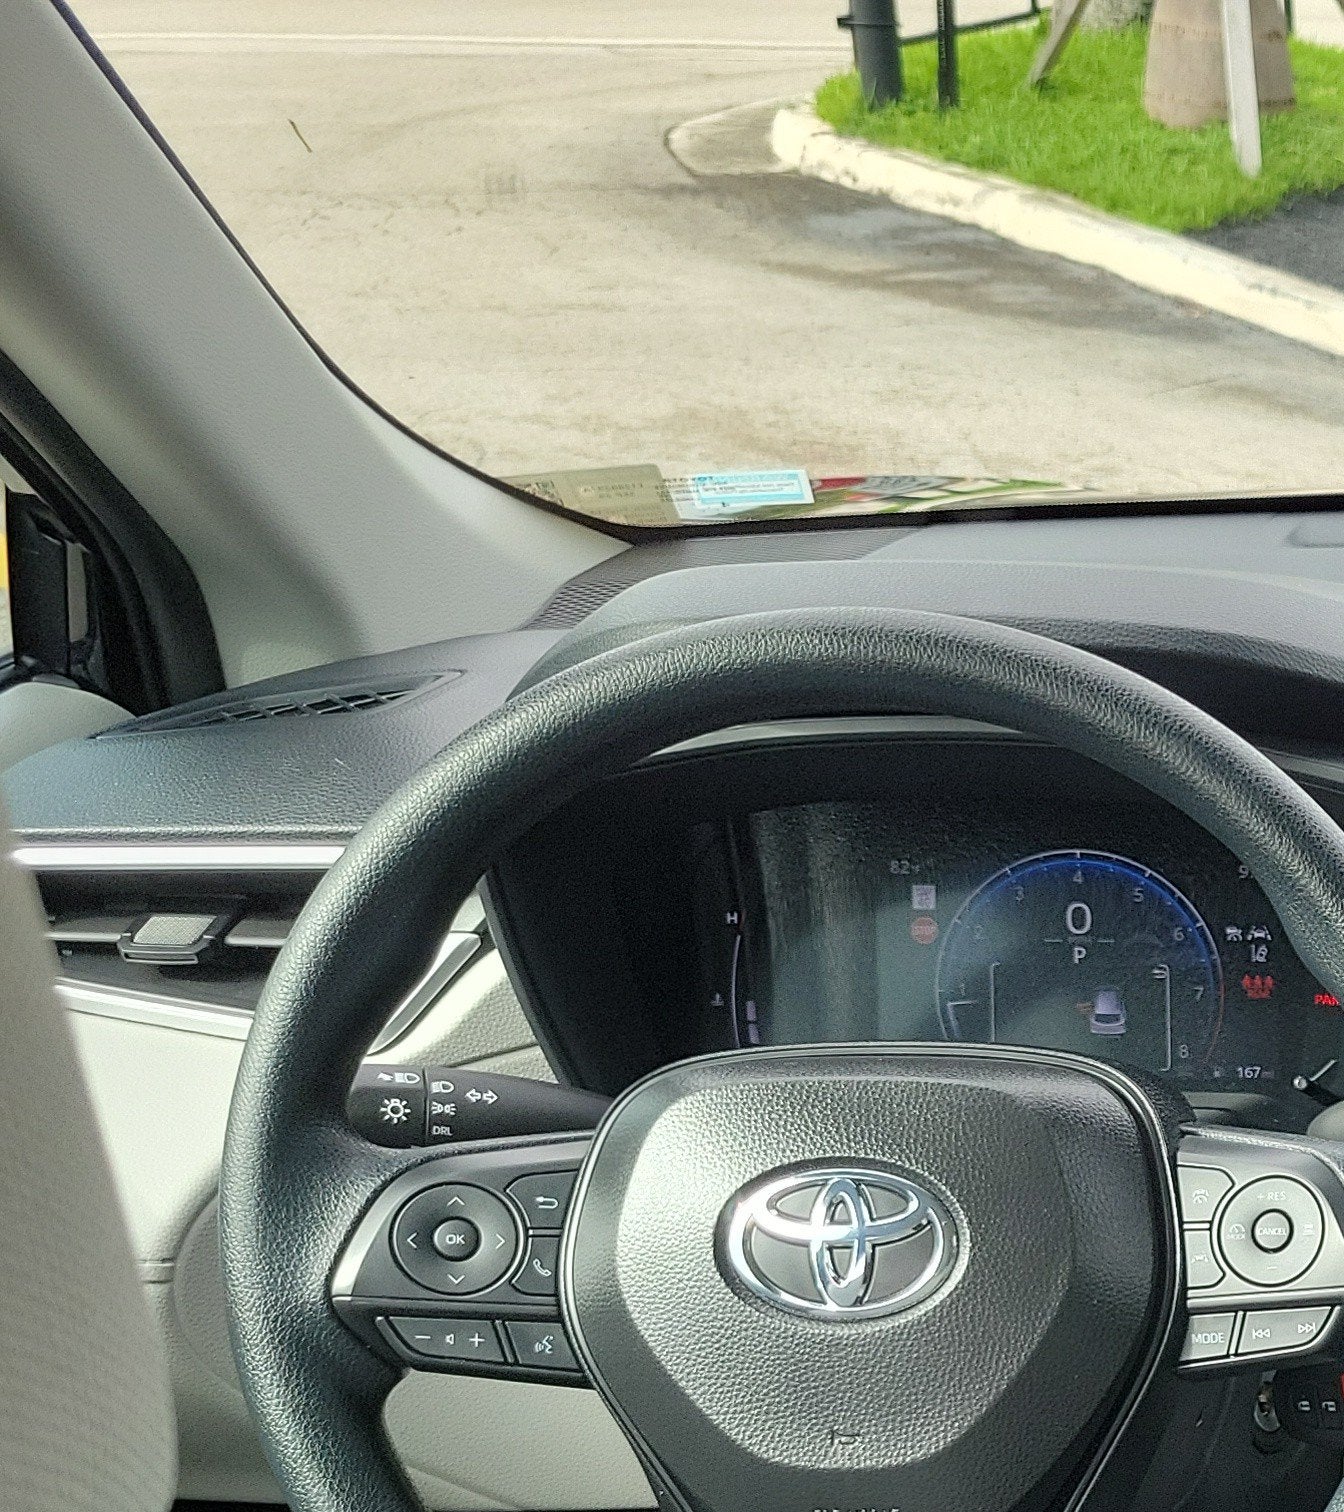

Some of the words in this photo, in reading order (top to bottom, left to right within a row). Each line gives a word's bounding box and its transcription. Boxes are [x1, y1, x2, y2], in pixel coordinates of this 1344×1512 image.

[1073, 870, 1083, 884] 4
[1015, 886, 1024, 901] 3
[1133, 887, 1144, 902] 5
[726, 912, 738, 924] H
[1173, 927, 1185, 941] 6
[1073, 947, 1087, 964] P
[1194, 986, 1204, 1000] 7
[1179, 1044, 1189, 1058] 8
[1237, 1066, 1261, 1078] 167
[432, 1125, 453, 1136] DRL
[1267, 1191, 1287, 1200] RES
[1257, 1227, 1287, 1236] CANCEL
[445, 1233, 465, 1246] OK
[1191, 1331, 1225, 1344] MODE
